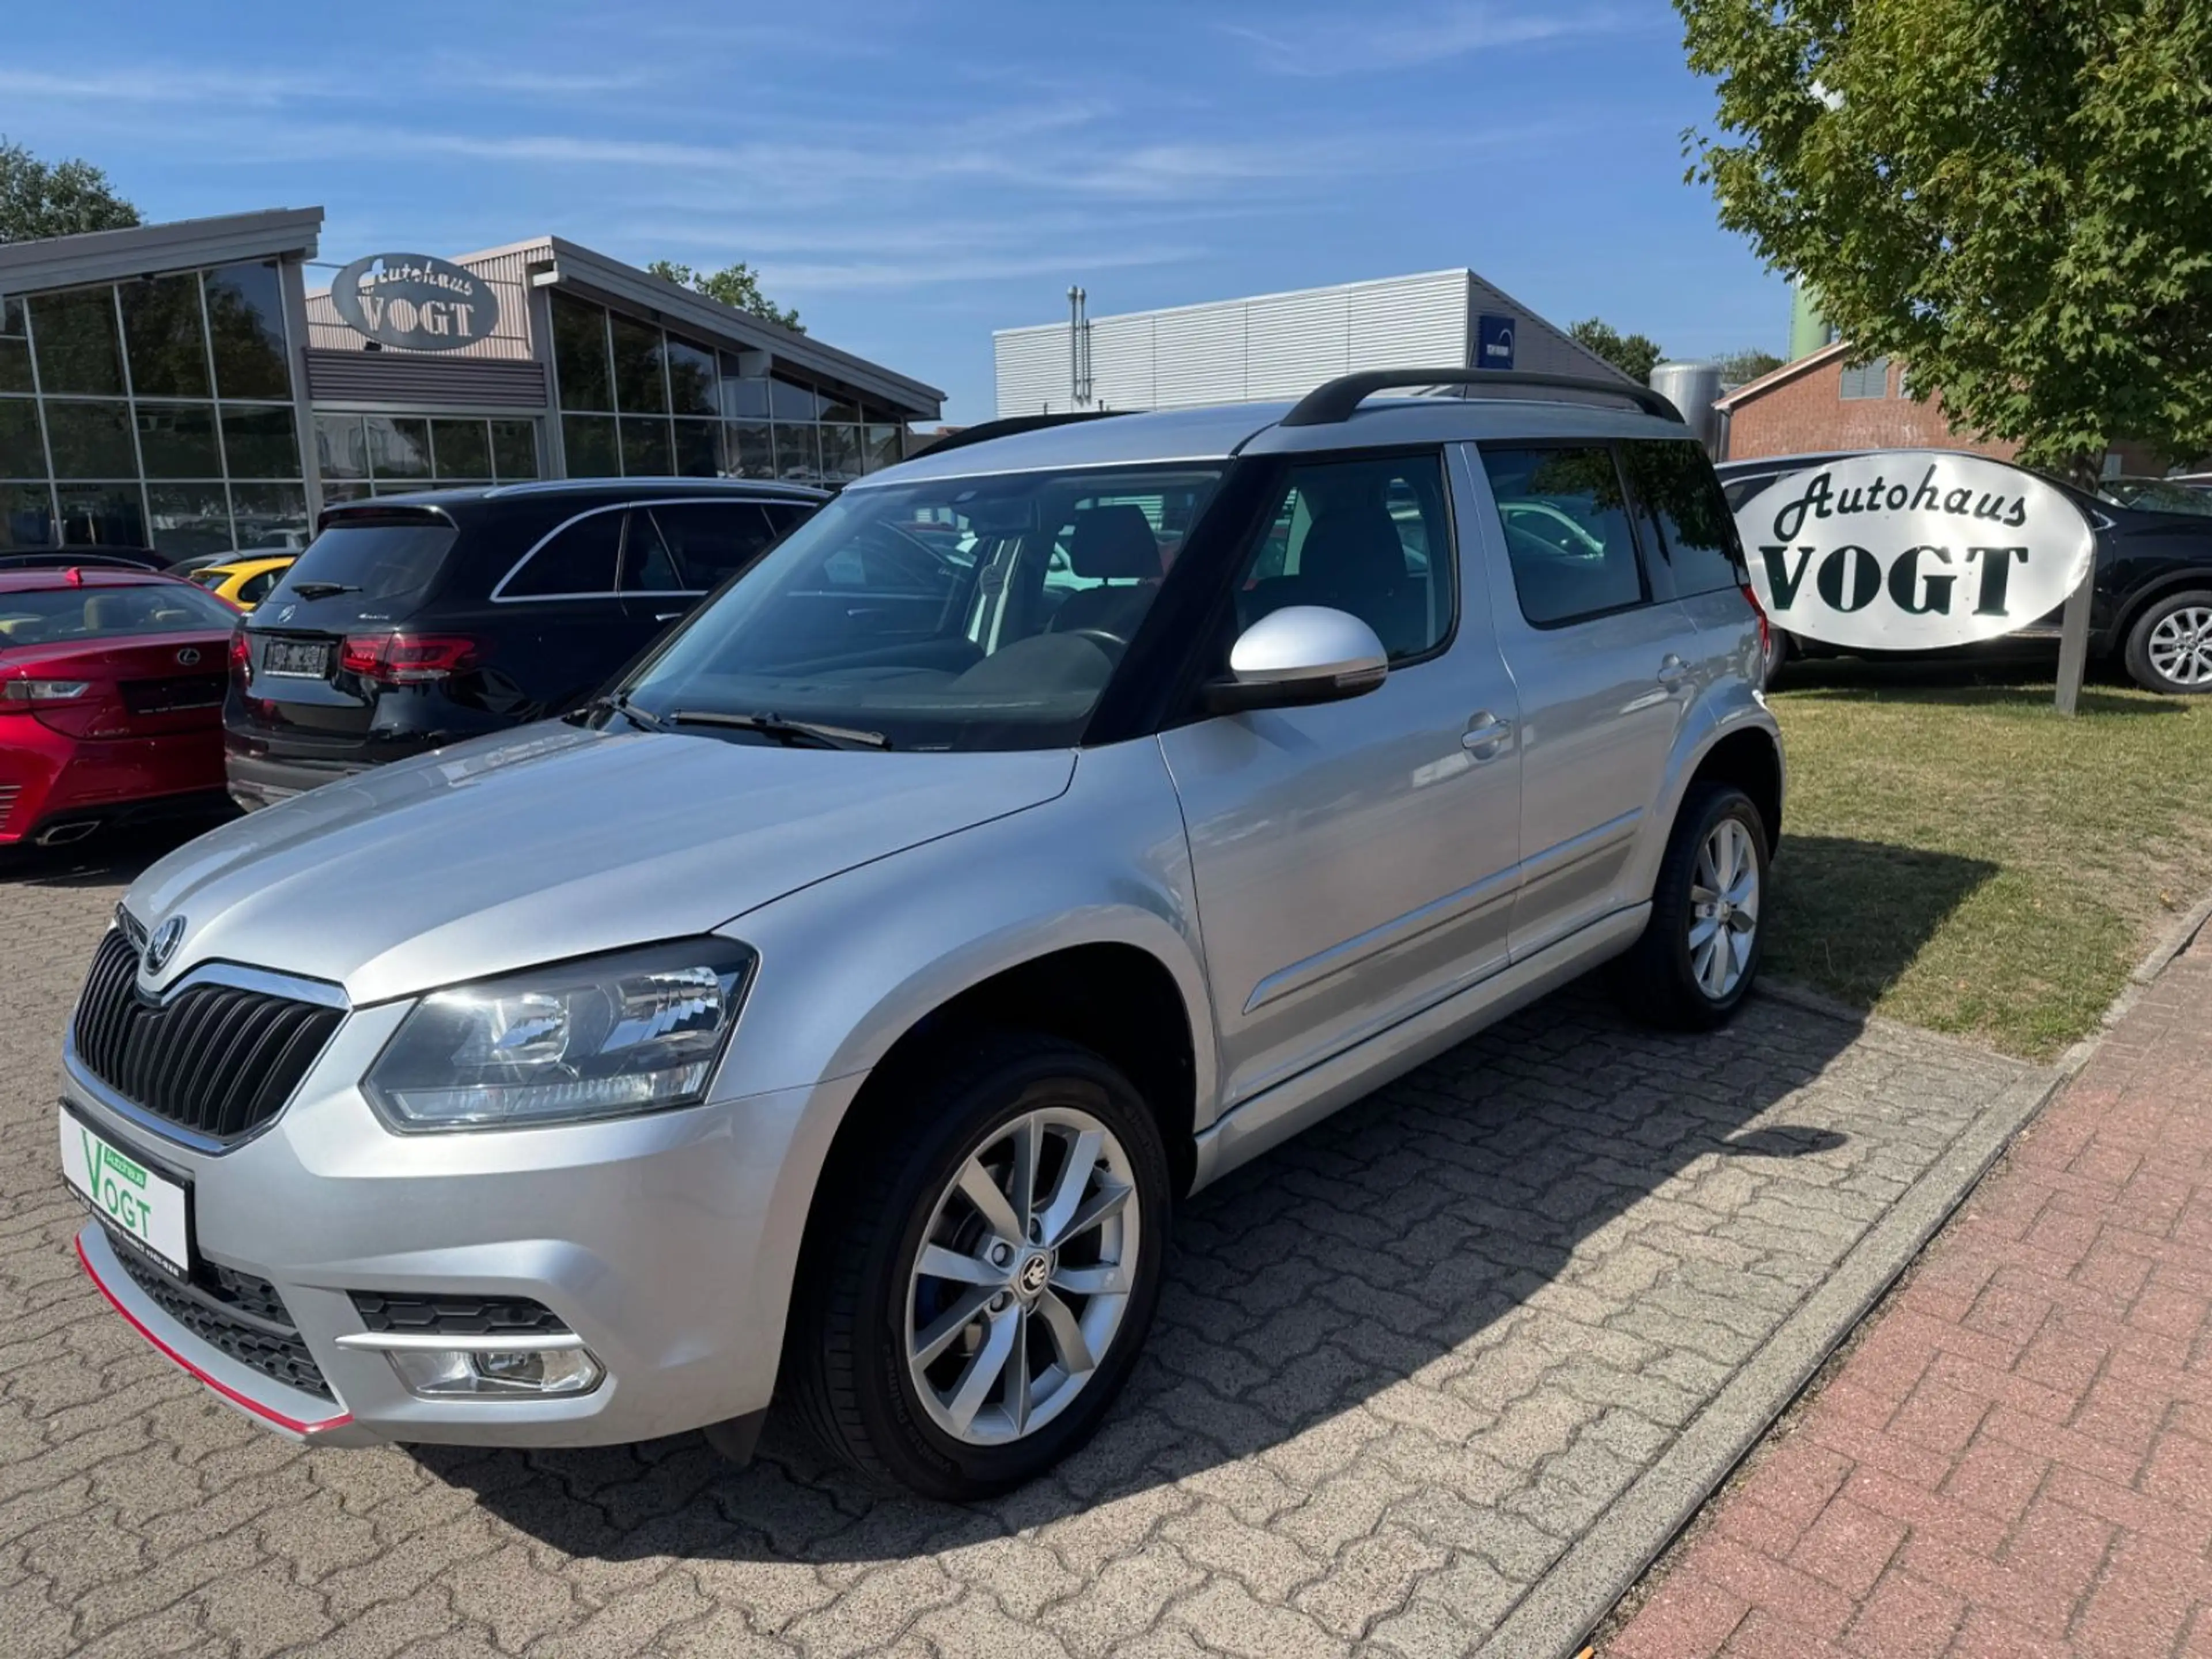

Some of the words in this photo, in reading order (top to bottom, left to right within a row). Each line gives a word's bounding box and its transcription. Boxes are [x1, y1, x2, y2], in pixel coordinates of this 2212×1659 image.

[357, 258, 473, 296] Autohaus
[357, 296, 475, 336] VOGT
[1773, 464, 2028, 541] Autohaus
[1759, 544, 2028, 616] VOGT
[81, 1127, 151, 1239] VOGT
